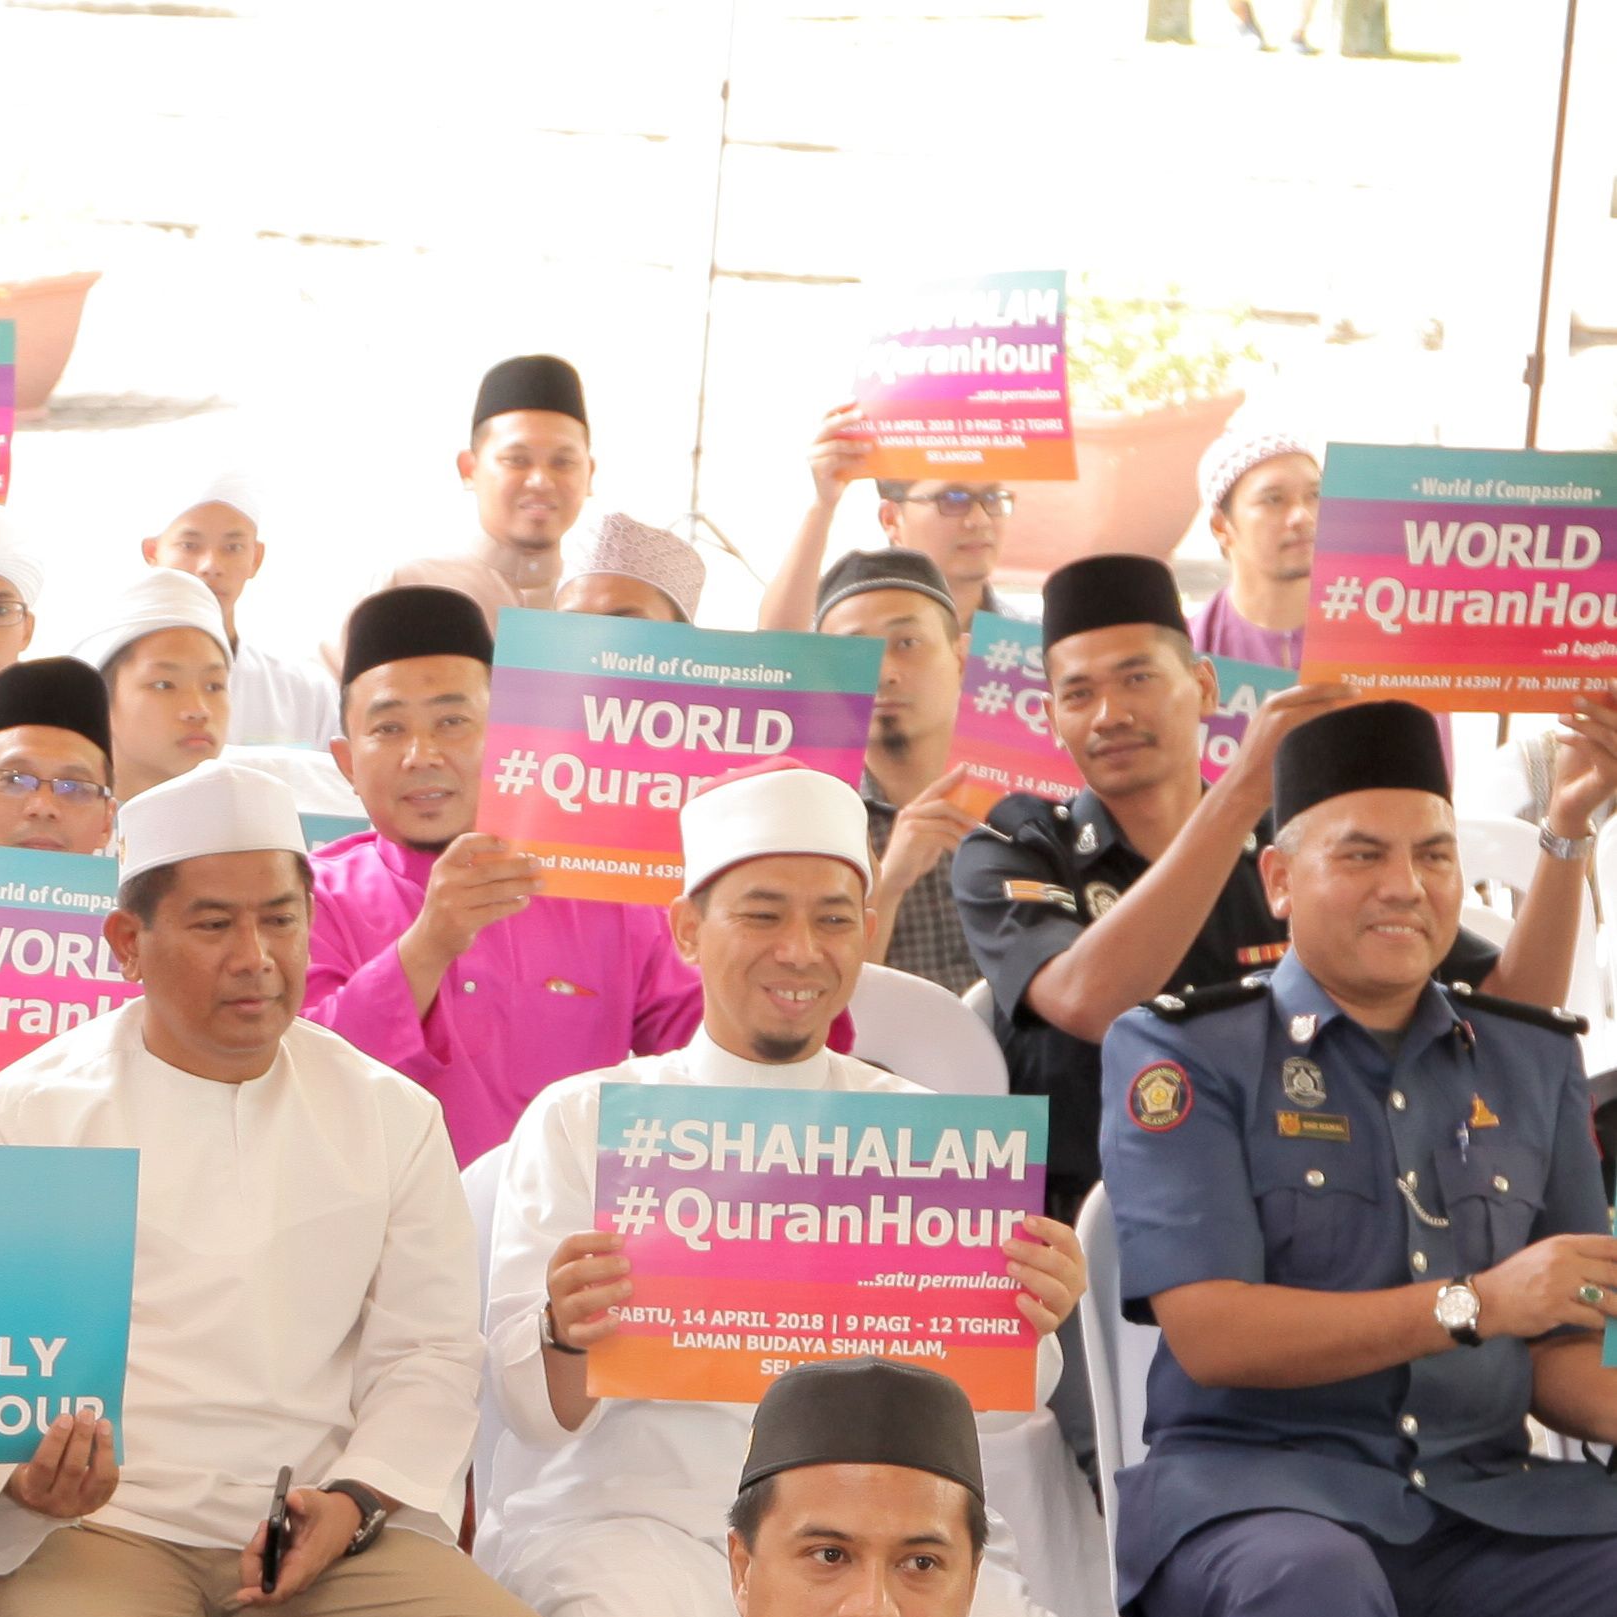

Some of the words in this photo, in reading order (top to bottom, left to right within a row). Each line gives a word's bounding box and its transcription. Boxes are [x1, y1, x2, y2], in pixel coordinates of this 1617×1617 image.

[1404, 519, 1602, 570] WORLD
[583, 694, 794, 755] WORLD
[618, 1119, 1028, 1181] #SHAHALAM
[611, 1186, 1027, 1251] #QuranHour
[607, 1305, 676, 1327] SABTU,
[682, 1310, 706, 1325] 14
[710, 1312, 771, 1328] APRIL
[775, 1313, 824, 1330] 2018
[846, 1316, 857, 1331] 9
[863, 1316, 912, 1333] PAGI
[930, 1318, 953, 1333] 12
[957, 1317, 1022, 1335] TGHRI
[672, 1332, 741, 1350] LAMAN
[746, 1335, 826, 1354] BUDAYA
[831, 1338, 884, 1356] SHAH
[889, 1340, 948, 1358] ALAM,
